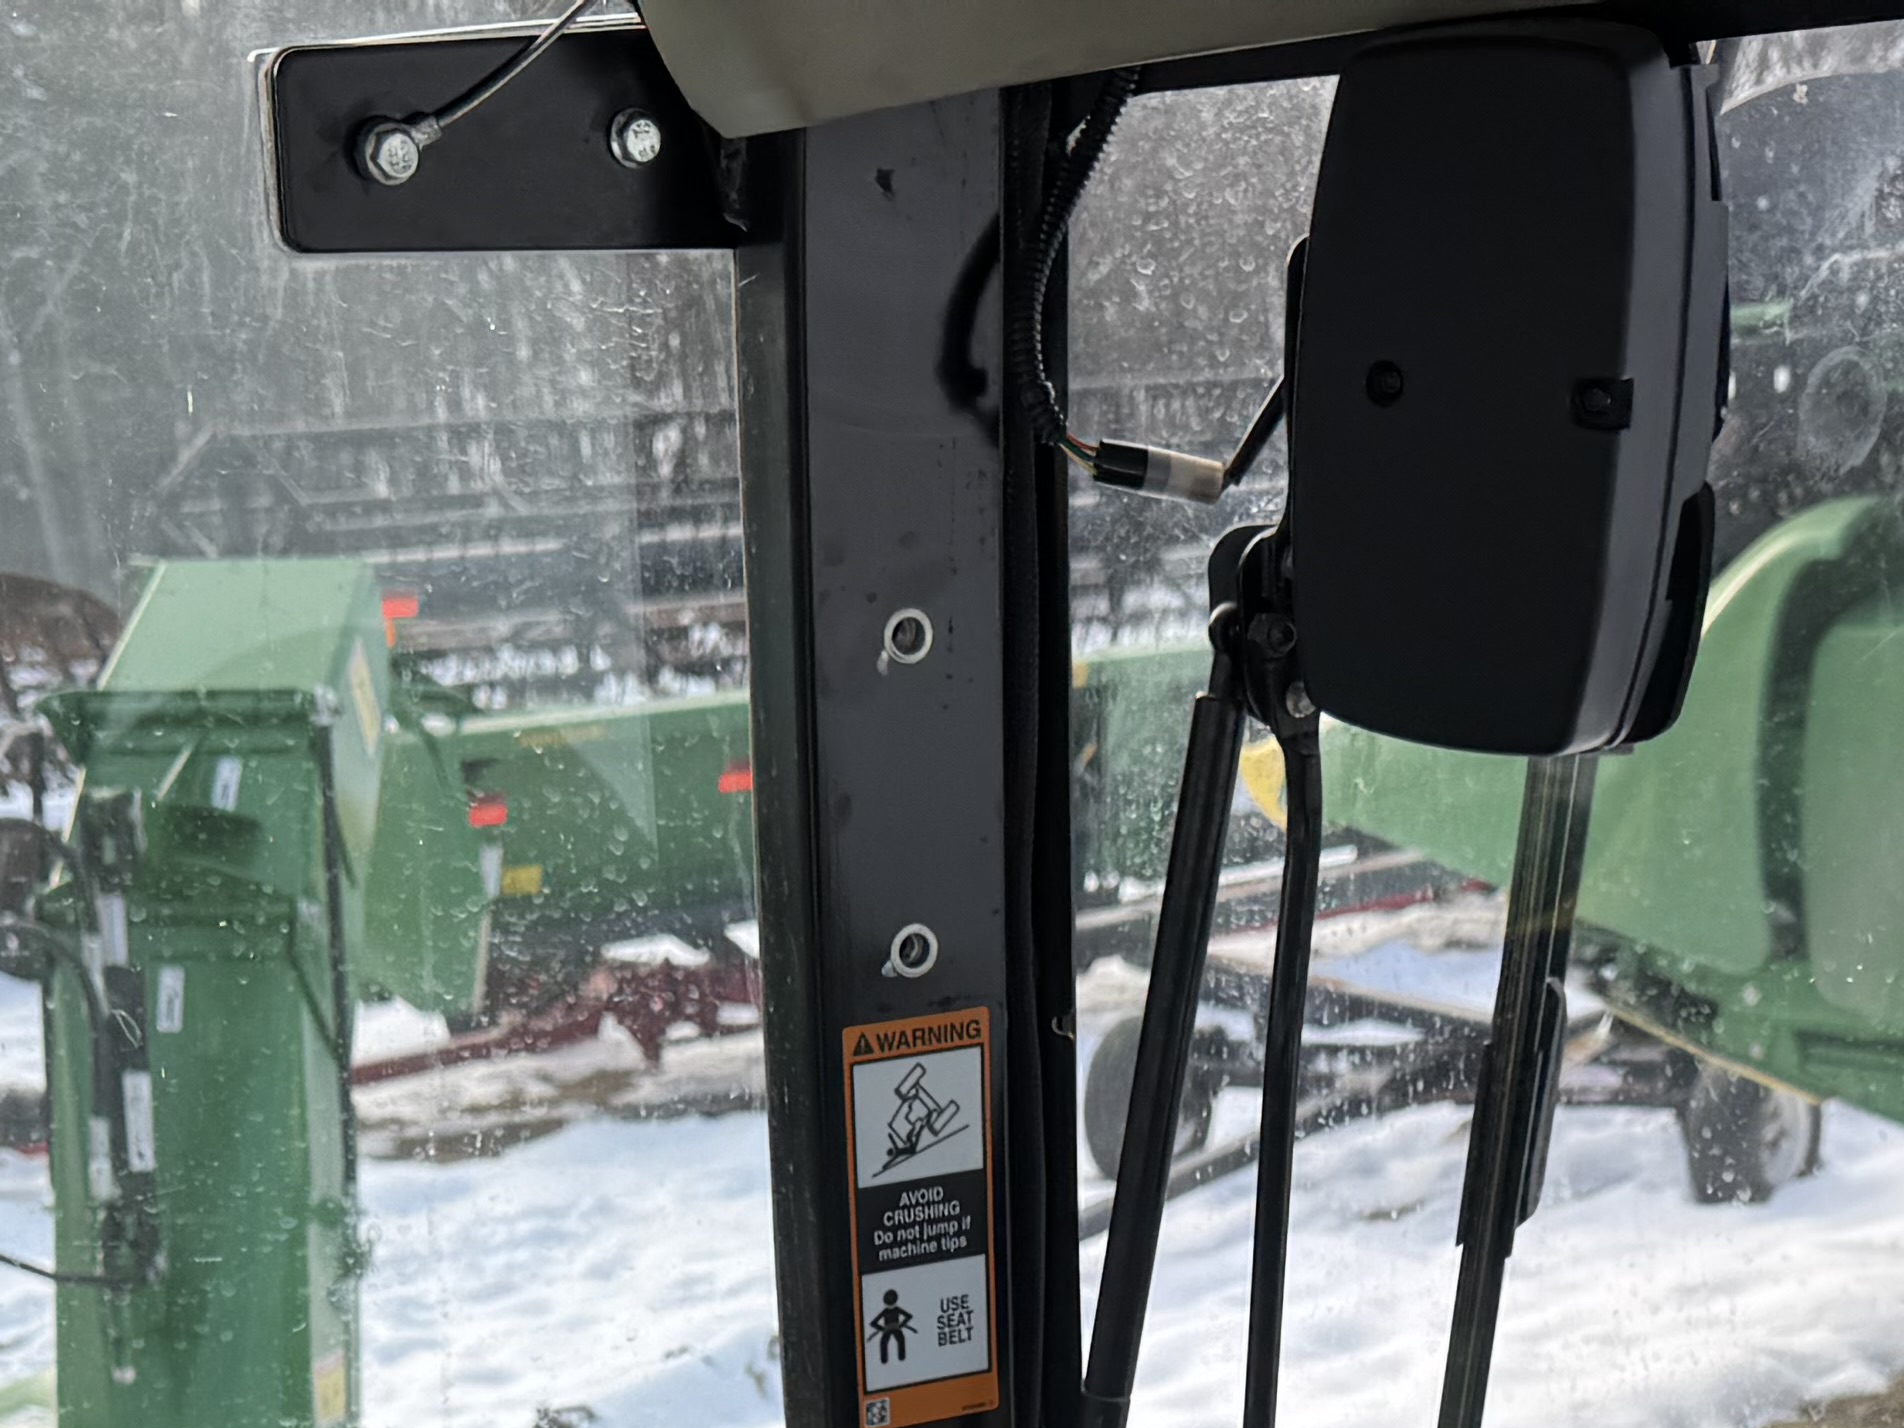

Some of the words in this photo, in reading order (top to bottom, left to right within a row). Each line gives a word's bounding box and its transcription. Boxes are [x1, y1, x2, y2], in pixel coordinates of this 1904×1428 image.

[876, 1019, 981, 1053] WARNING
[899, 1186, 944, 1207] AVOID
[883, 1200, 960, 1226] CRUSHING
[874, 1230, 894, 1246] Do
[897, 1225, 920, 1242] not
[923, 1221, 959, 1241] jump
[962, 1215, 971, 1231] if
[878, 1240, 938, 1261] machine
[941, 1234, 968, 1253] tips
[940, 1293, 970, 1314] USE
[937, 1310, 974, 1330] SEAT
[937, 1326, 974, 1347] BELT
